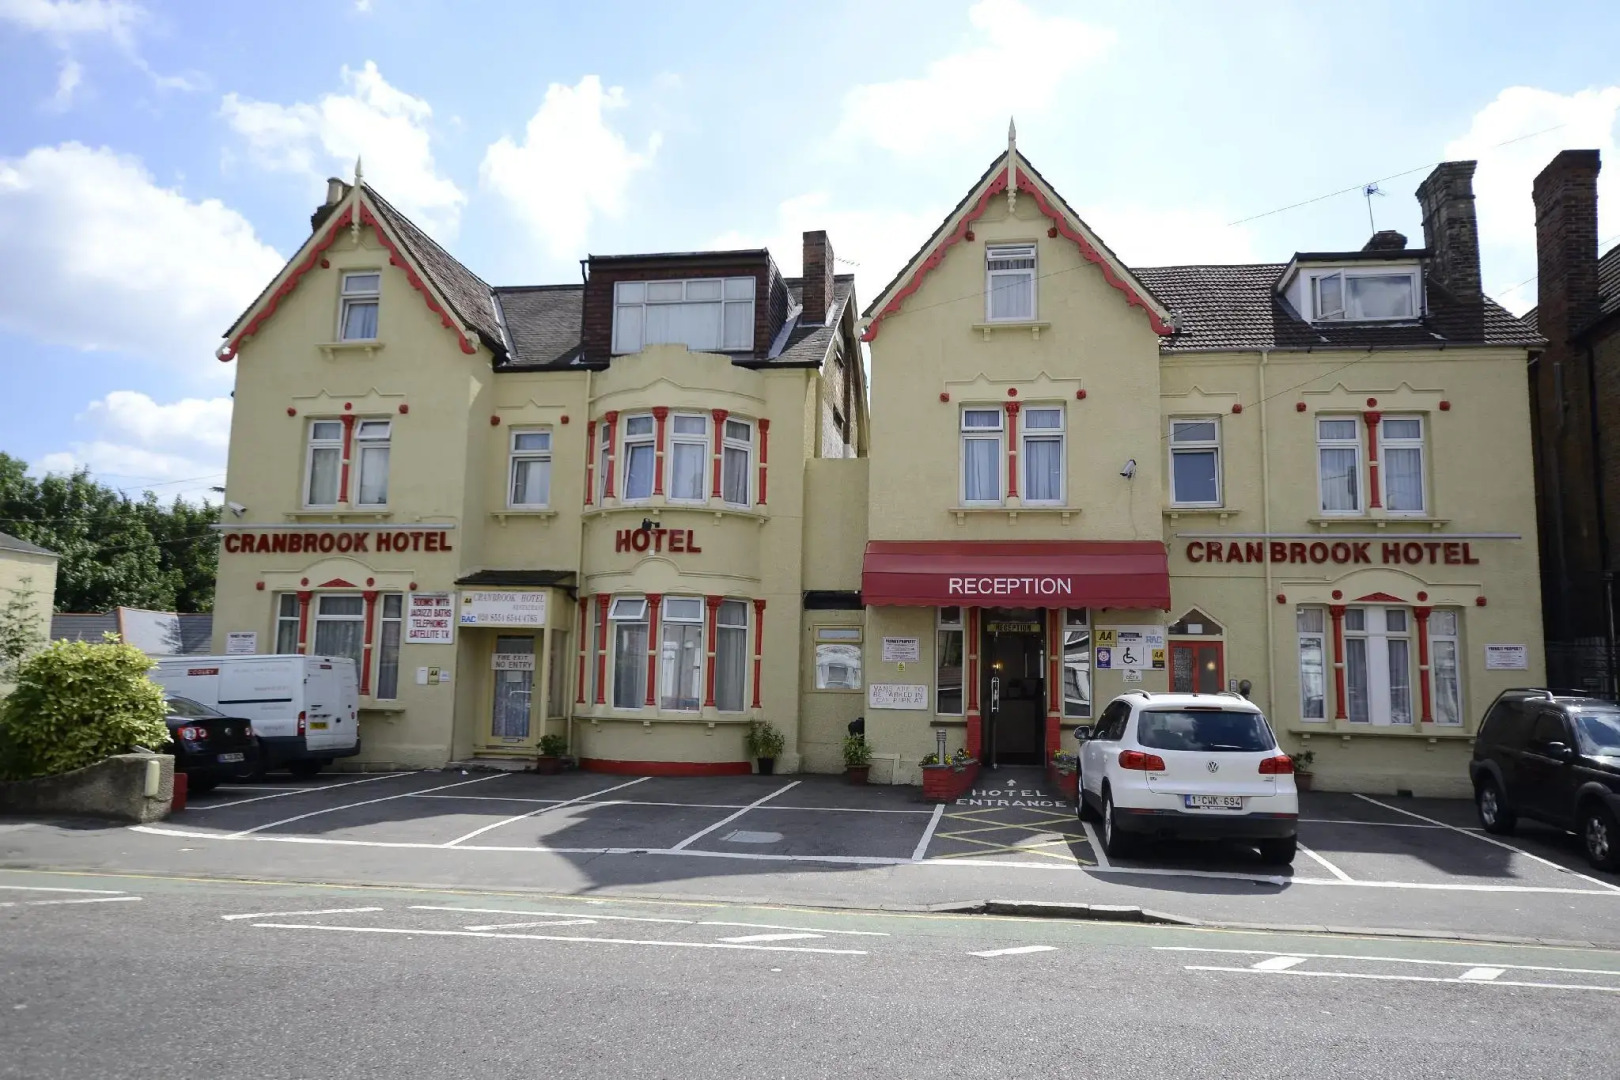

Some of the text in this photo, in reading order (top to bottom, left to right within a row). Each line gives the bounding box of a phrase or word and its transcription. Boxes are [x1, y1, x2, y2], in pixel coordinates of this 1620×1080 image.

[224, 531, 453, 553] CRANBROOK HOTEL
[615, 528, 702, 553] HOTEL
[1186, 541, 1480, 565] CRANBROOK HOTEL
[948, 577, 1072, 595] RECEPTION
[435, 597, 450, 606] WITH
[473, 593, 545, 602] CRANBROOK HOTEL
[410, 608, 452, 617] JACUZZI BATHS
[412, 619, 448, 628] TELEPHONES
[461, 615, 476, 623] RAC
[409, 629, 440, 639] SATELLITE
[1099, 631, 1112, 641] AA
[1146, 635, 1162, 644] RAC
[508, 661, 532, 669] ENTRY
[972, 788, 1048, 797] HOTEL
[955, 798, 1067, 808] ENTRANCE
